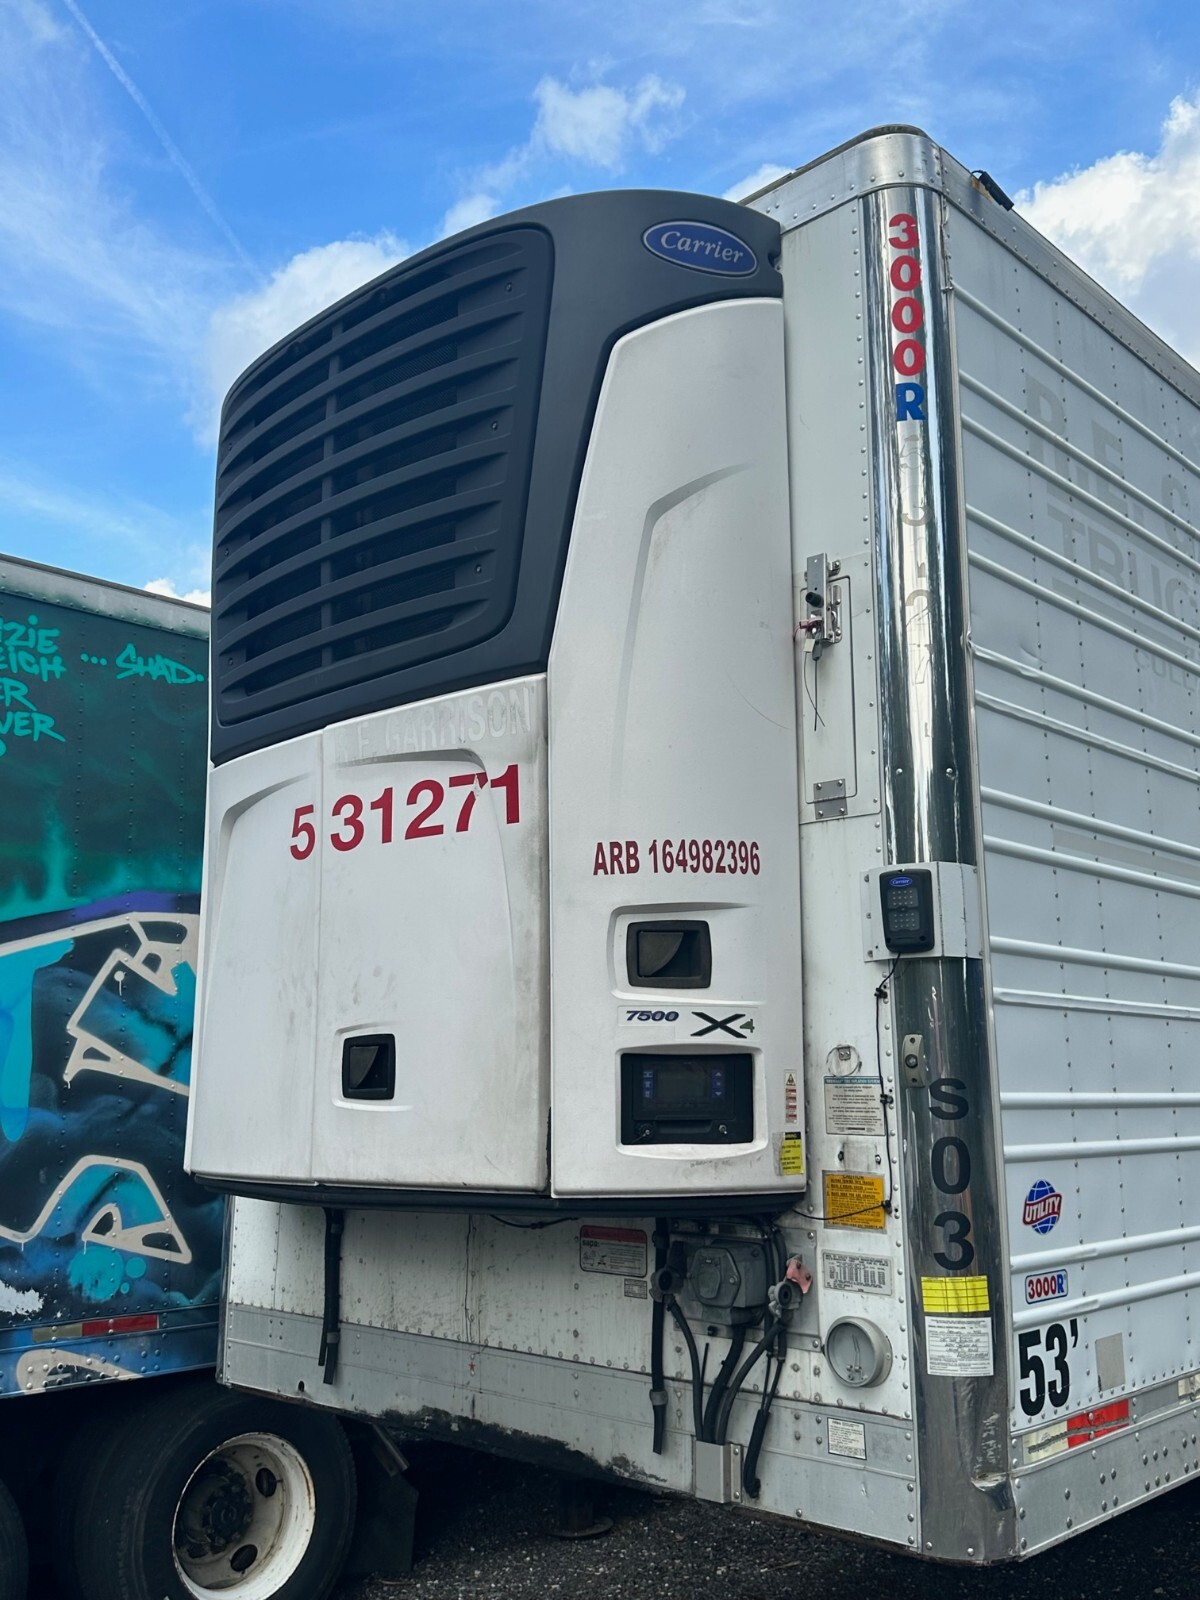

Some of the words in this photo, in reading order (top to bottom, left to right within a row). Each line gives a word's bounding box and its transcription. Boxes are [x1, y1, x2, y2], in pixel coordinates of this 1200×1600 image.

[660, 230, 744, 263] Carrier
[888, 212, 926, 422] 3000R
[593, 840, 640, 876] ARB
[648, 839, 761, 876] 164982396
[626, 1010, 679, 1022] 7500
[1025, 1196, 1060, 1222] UTILITY
[1027, 1272, 1065, 1300] 3000R
